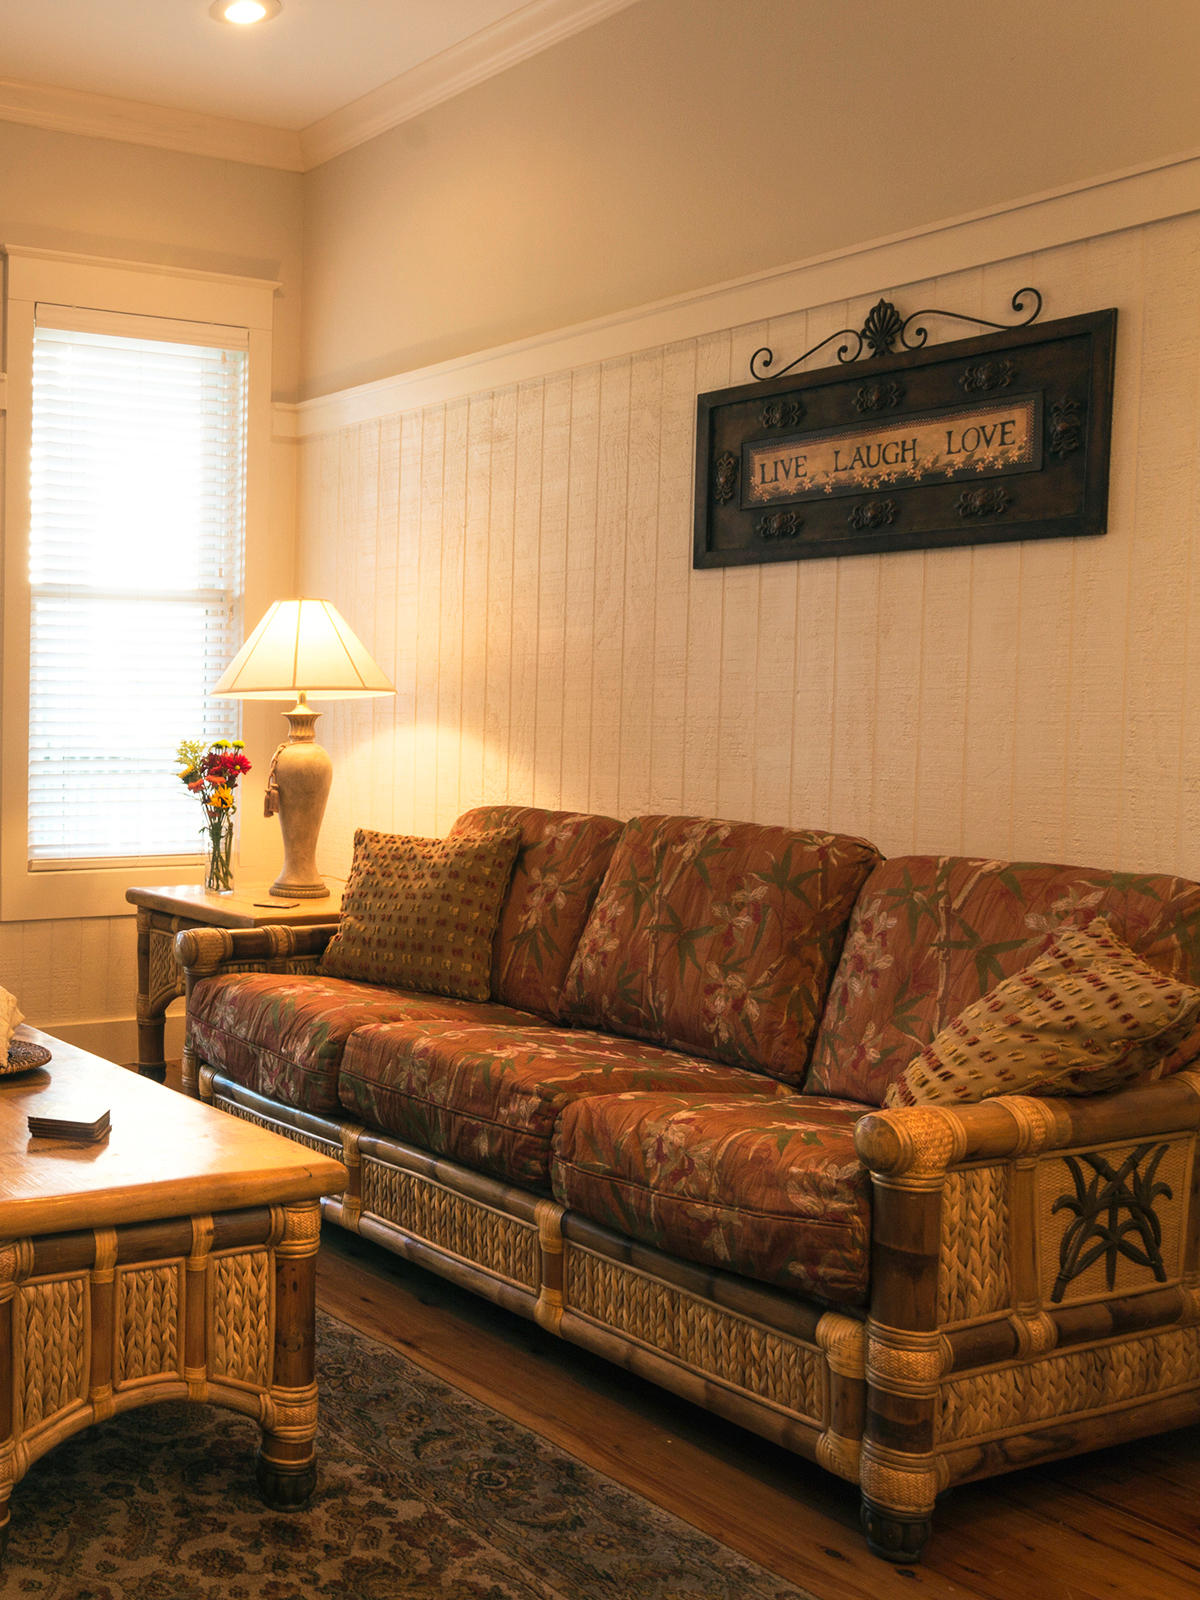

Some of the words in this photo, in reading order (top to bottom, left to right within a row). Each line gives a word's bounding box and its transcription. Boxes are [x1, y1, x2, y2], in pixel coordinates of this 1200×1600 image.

[760, 455, 808, 485] LIVE
[833, 438, 917, 473] LAUGH
[945, 420, 1016, 455] LOVE
